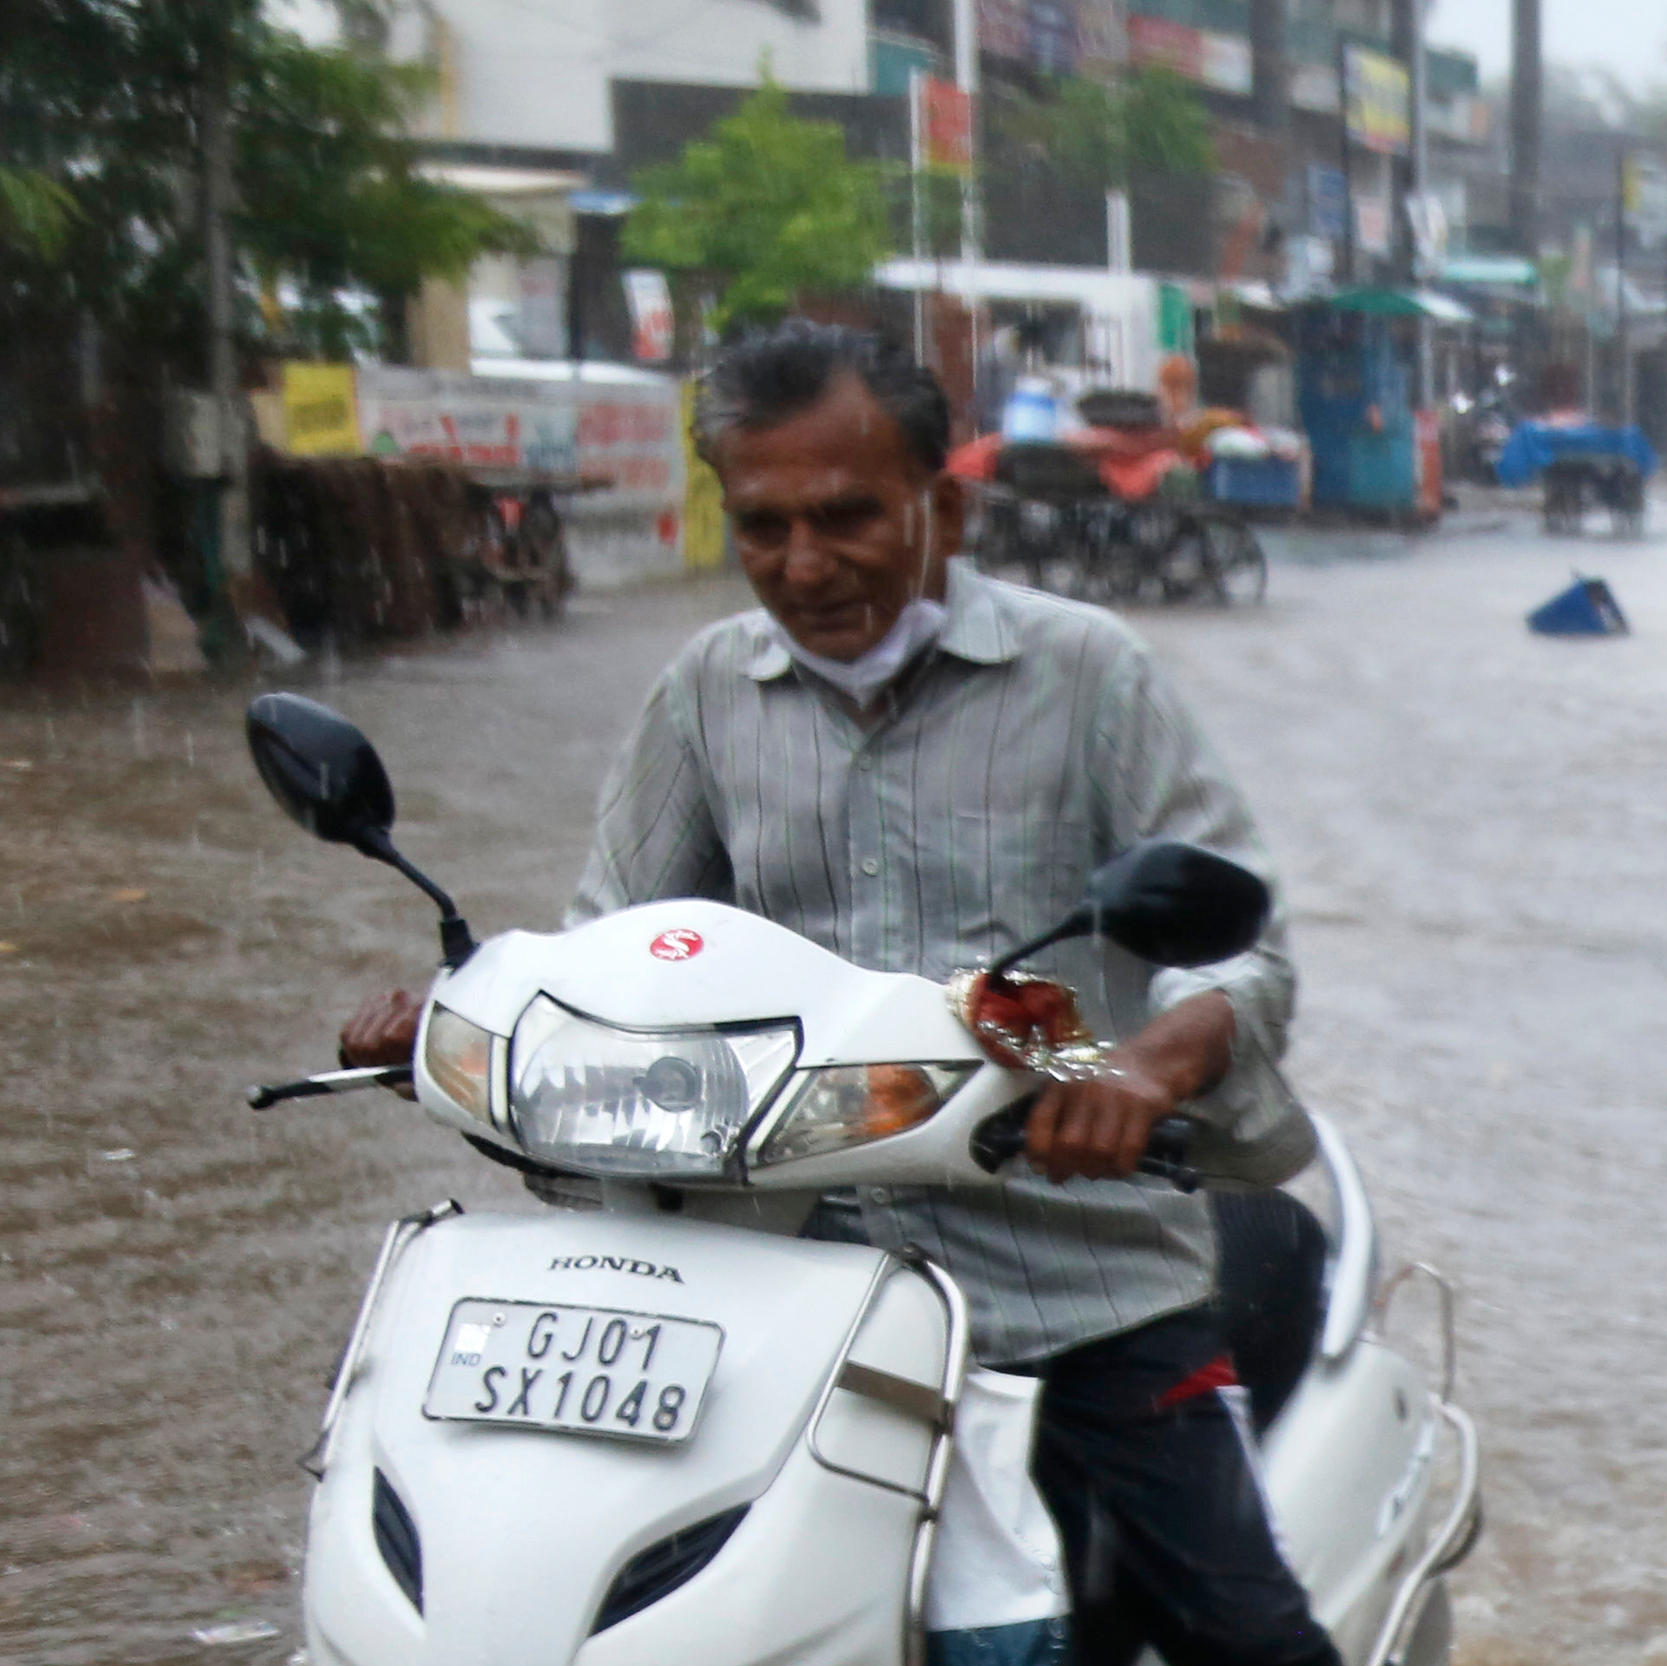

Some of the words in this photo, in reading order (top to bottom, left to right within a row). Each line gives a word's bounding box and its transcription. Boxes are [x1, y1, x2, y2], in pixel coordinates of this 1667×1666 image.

[548, 1255, 685, 1284] HONDA
[451, 1352, 481, 1367] IND
[527, 1312, 662, 1371] GJ01
[475, 1366, 686, 1431] SX1048
